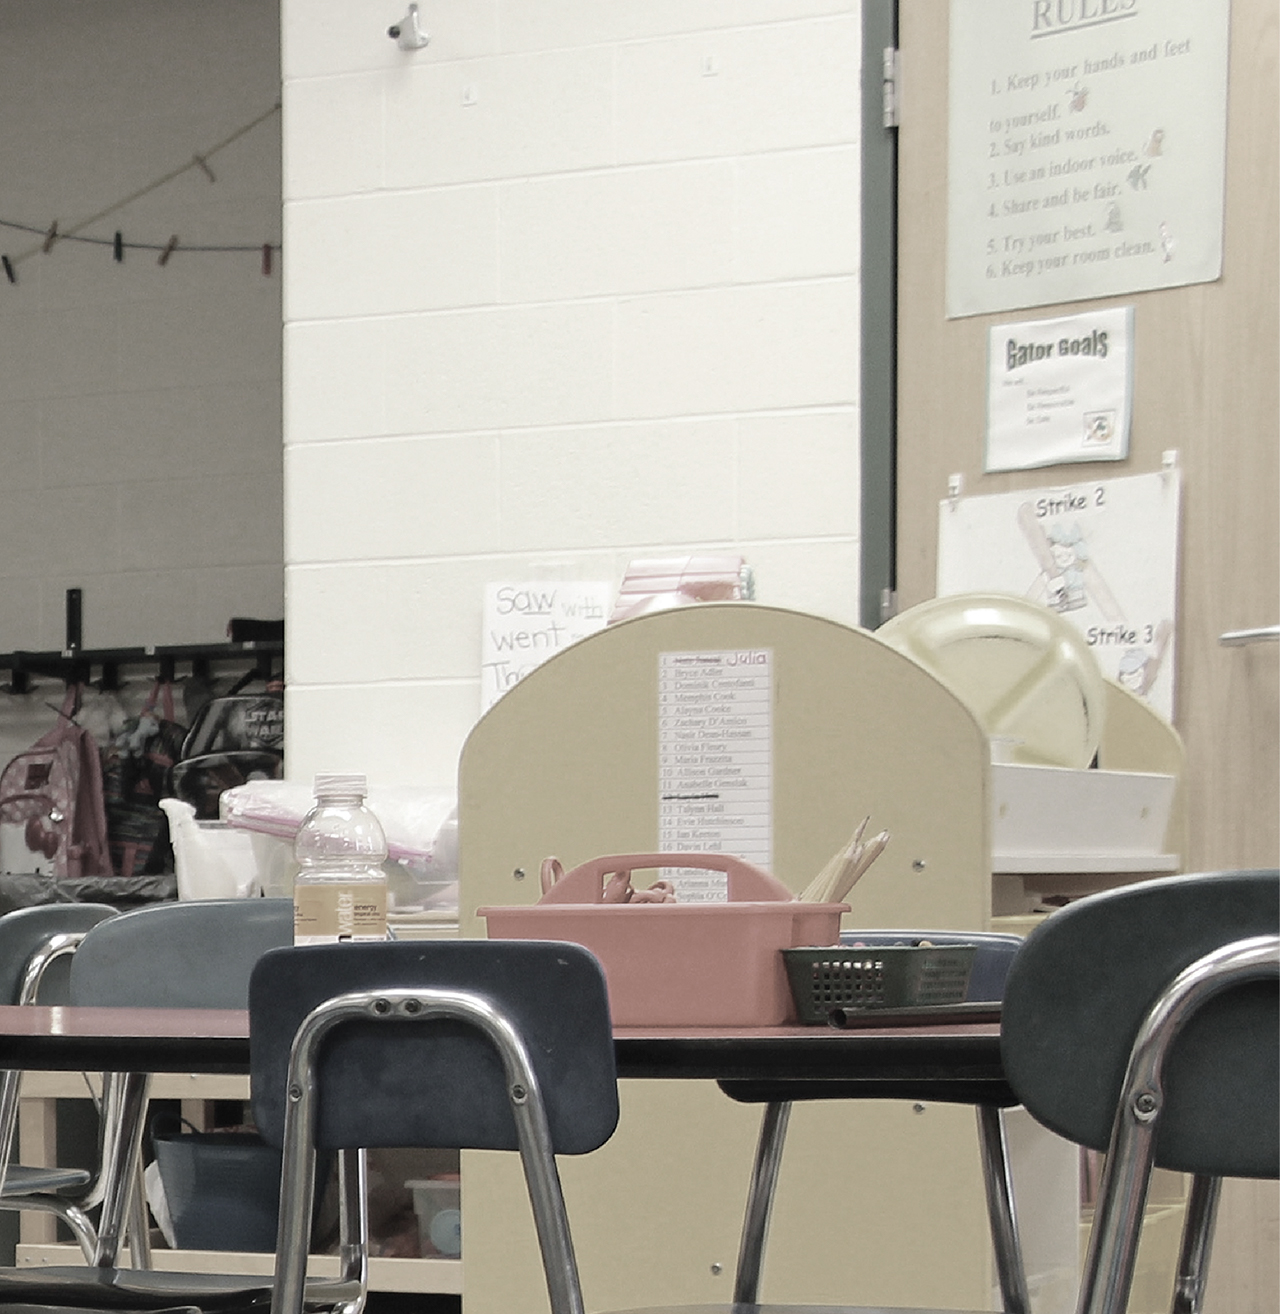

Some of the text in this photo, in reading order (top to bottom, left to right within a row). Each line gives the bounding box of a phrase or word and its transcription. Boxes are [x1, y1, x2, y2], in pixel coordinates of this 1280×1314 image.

[1007, 73, 1039, 91] Keep
[1045, 65, 1077, 85] your
[1083, 55, 1125, 74] hands
[1130, 47, 1157, 65] and
[1164, 39, 1191, 58] feet
[1004, 138, 1025, 157] Say
[1030, 129, 1060, 149] kind
[1049, 159, 1095, 177] indoor
[1003, 199, 1039, 216] Share
[1043, 190, 1068, 207] and
[1073, 187, 1089, 201] be
[1004, 234, 1025, 255] Try
[1029, 231, 1060, 251] your
[1001, 259, 1034, 277] Keep
[1073, 249, 1110, 265] room
[1006, 329, 1108, 372] Gator Goals
[1036, 486, 1106, 518] Strike 2
[496, 587, 558, 616] Saw
[491, 620, 566, 651] went
[1086, 624, 1154, 647] Strike 3
[726, 651, 767, 667] Julia
[482, 661, 525, 692] Th
